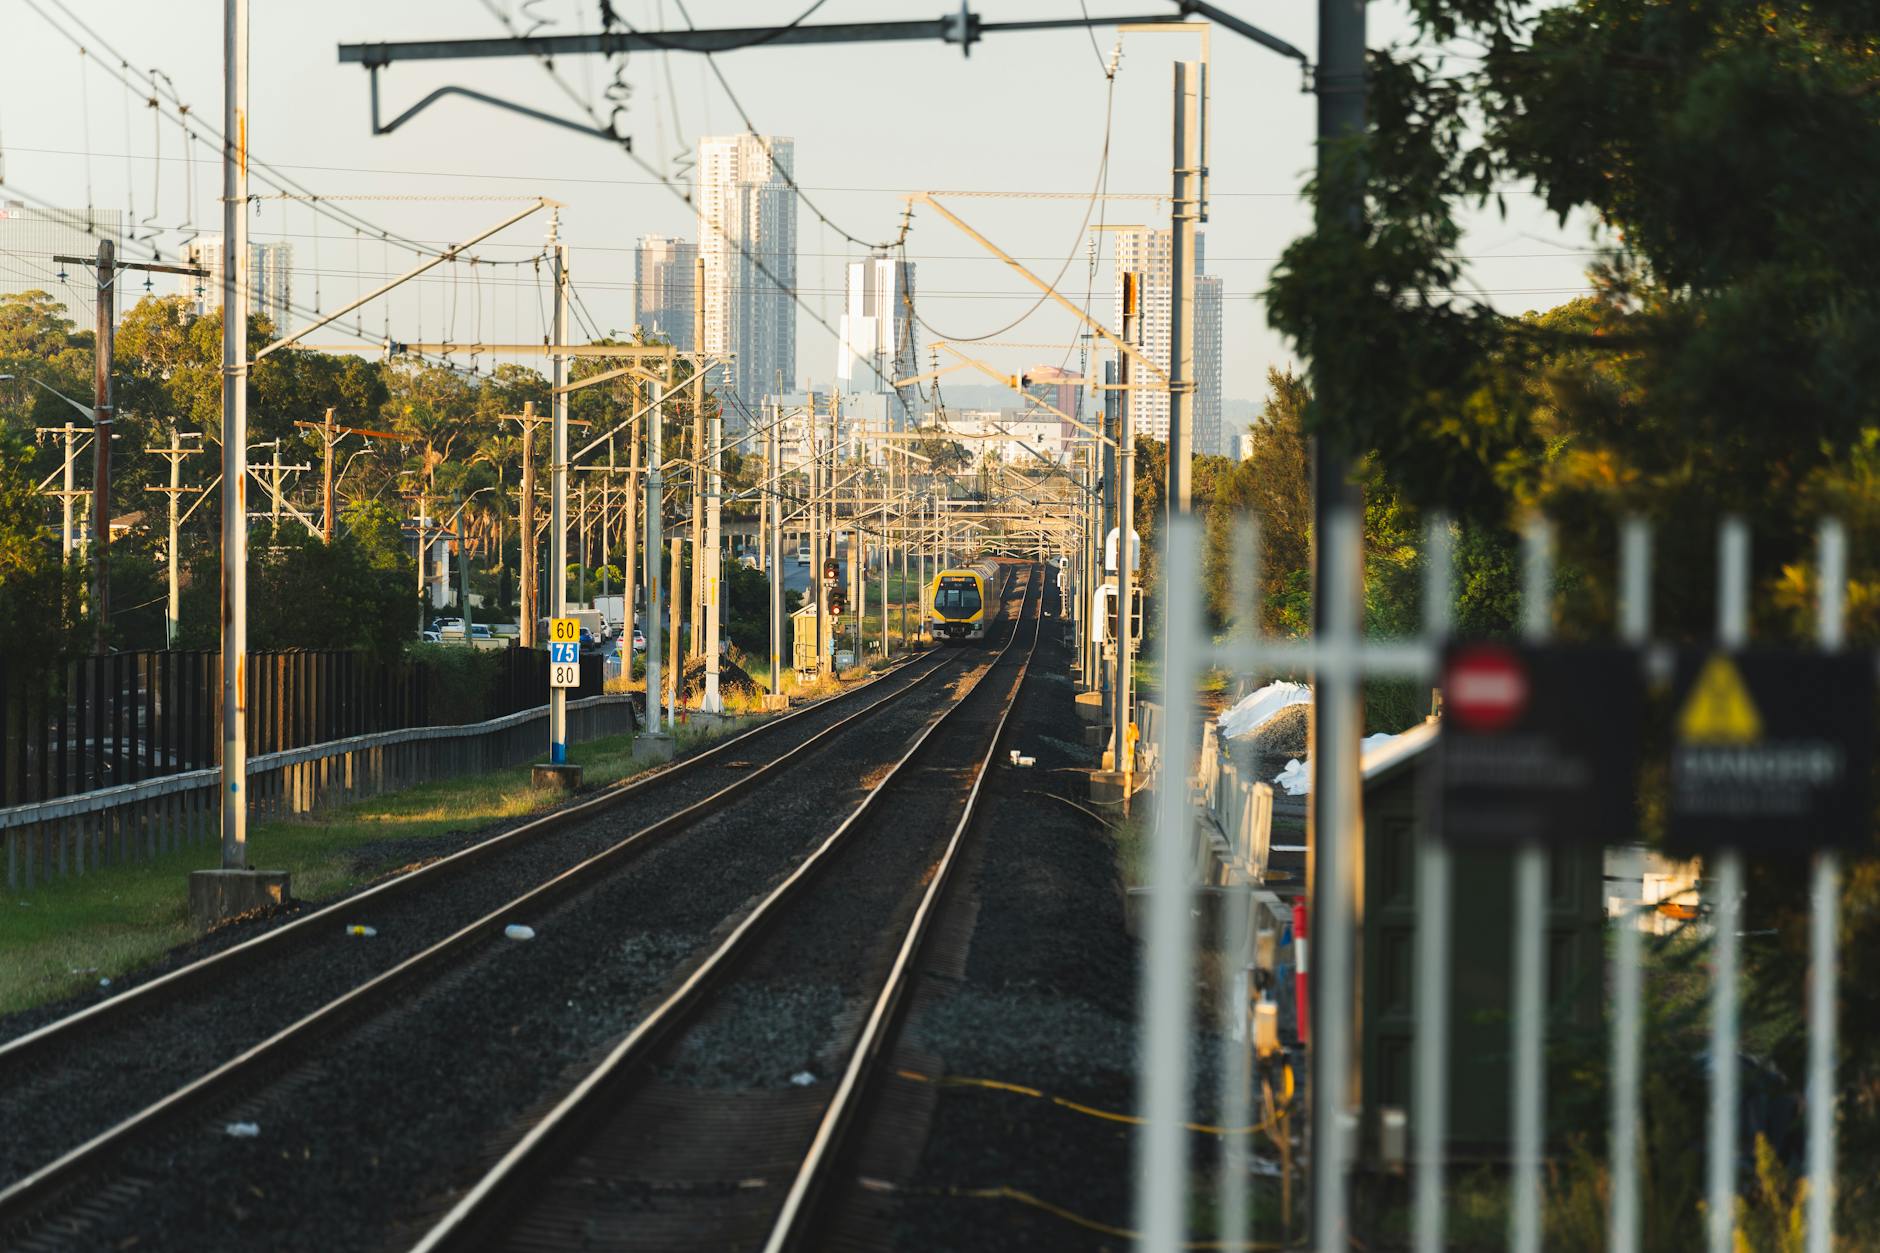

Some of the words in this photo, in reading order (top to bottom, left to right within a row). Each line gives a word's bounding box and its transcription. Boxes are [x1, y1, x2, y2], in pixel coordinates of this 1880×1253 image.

[557, 622, 574, 639] 60
[556, 643, 574, 662] 75
[556, 666, 574, 684] 80
